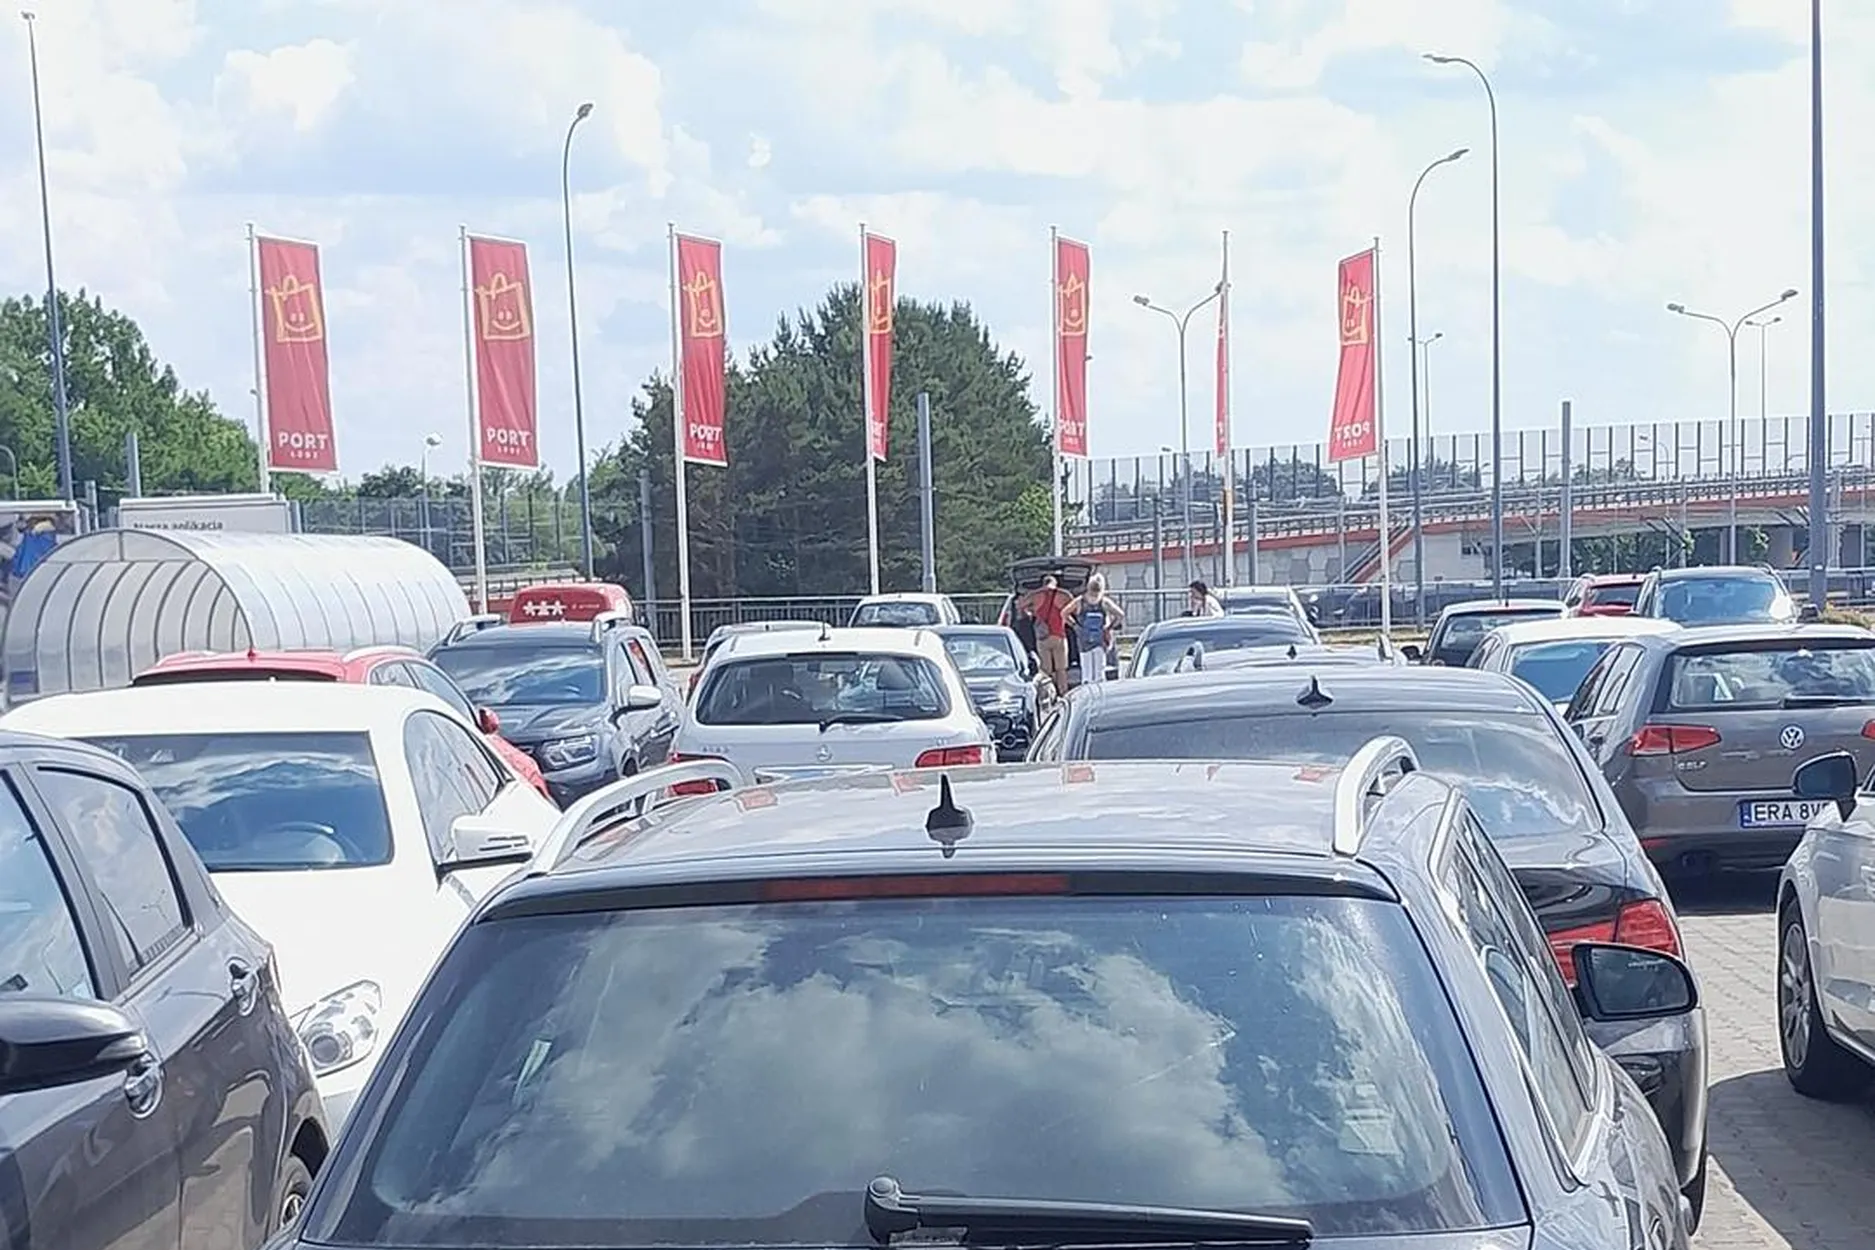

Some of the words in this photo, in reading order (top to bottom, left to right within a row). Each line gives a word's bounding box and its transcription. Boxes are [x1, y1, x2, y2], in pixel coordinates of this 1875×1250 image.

[278, 431, 329, 449] PORT
[486, 427, 531, 446] PORT
[688, 423, 723, 441] PORT
[1754, 803, 1793, 821] ERA
